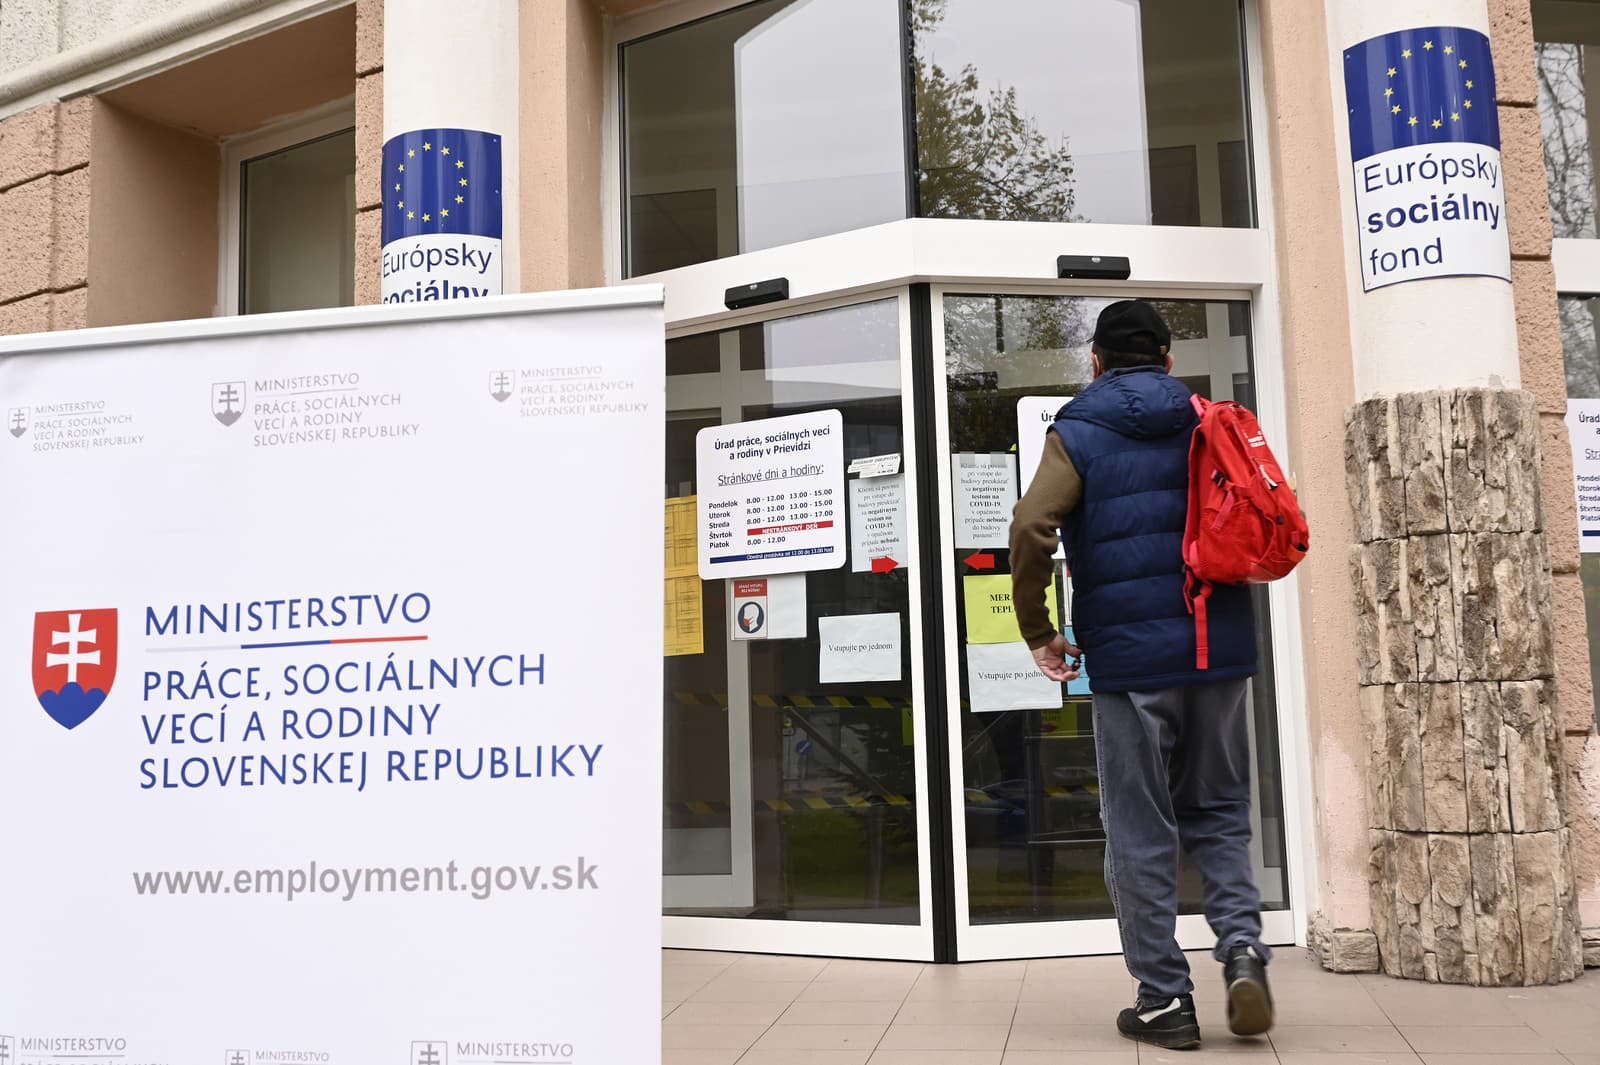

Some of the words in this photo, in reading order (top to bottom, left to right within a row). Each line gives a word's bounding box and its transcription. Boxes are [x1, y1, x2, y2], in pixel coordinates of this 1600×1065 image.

[1364, 153, 1497, 192] Európsky
[1367, 193, 1499, 233] sociálny
[383, 243, 492, 278] Európsky
[1369, 237, 1443, 275] fond
[521, 366, 602, 378] MINISTERSTVO
[254, 373, 360, 392] MINISTERSTVO
[560, 380, 634, 393] SOCIÁLNYCH
[35, 401, 105, 414] MINISTERSTVO
[254, 400, 300, 415] PRÁCE,
[304, 393, 401, 411] SOCIÁLNYCH
[521, 395, 545, 406] VECÍ
[549, 396, 557, 404] A
[560, 393, 606, 403] RODINY
[520, 405, 585, 416] SLOVENSKEJ
[590, 402, 649, 414] REPUBLIKY
[1041, 409, 1056, 422] Úr
[1579, 411, 1600, 423] Úrad
[68, 415, 132, 428] SOCIÁLNYCH
[254, 415, 285, 431] VECÍ
[290, 416, 299, 427] A
[304, 411, 363, 426] RODINY
[34, 431, 54, 440] VECÍ
[68, 428, 106, 437] RODINY
[254, 428, 336, 447] SLOVENSKEJ
[343, 424, 420, 439] REPUBLIKY
[714, 438, 734, 450] Úrad
[737, 436, 762, 449] práce,
[765, 429, 810, 443] sociálnych
[812, 425, 830, 436] vecí
[33, 440, 89, 452] SLOVENSKEJ
[93, 435, 144, 447] REPUBLIKY
[729, 452, 734, 460] a
[737, 447, 763, 459] rodiny
[773, 441, 811, 454] Prievidzi
[718, 469, 762, 484] Stránkové
[765, 467, 779, 479] dni
[782, 469, 787, 478] a
[791, 464, 824, 477] hodiny:
[709, 500, 738, 509] Pondelok
[747, 496, 761, 504] 8.00
[767, 494, 785, 503] 12.00
[789, 491, 808, 499] 13.00
[814, 489, 833, 497] 15.00
[709, 511, 730, 520] Utorok
[747, 507, 761, 515] 8.00
[767, 505, 785, 513] 12.00
[789, 502, 808, 510] 13.00
[814, 499, 833, 507] 15.00
[709, 520, 730, 529] Streda
[747, 517, 761, 525] 8.00
[767, 515, 785, 523] 12.00
[790, 512, 808, 520] 13.00
[815, 510, 833, 518] 17.00
[709, 530, 732, 540] Štvrtok
[709, 541, 730, 549] Piatok
[747, 538, 762, 546] 8.00
[768, 536, 786, 544] 12.00
[990, 594, 1010, 602] MER
[145, 592, 431, 636] MINISTERSTVO
[990, 606, 1014, 614] TEPL
[828, 643, 858, 654] Vstupujte
[859, 644, 867, 652] po
[868, 642, 893, 653] jednom
[143, 661, 272, 701] PRÁCE,
[283, 653, 546, 695] SOCIÁLNYCH
[977, 670, 1013, 681] Vstupujte
[1014, 672, 1024, 680] po
[1024, 670, 1046, 680] jedno
[141, 705, 228, 745] VECÍ
[242, 711, 267, 743] A
[282, 703, 441, 741] RODINY
[139, 751, 366, 792] SLOVENSKEJ
[386, 744, 604, 783] REPUBLIKY
[133, 857, 600, 901] www.employment.gov.sk
[21, 1037, 127, 1051] MINISTERSTVO
[457, 1042, 575, 1057] MINISTERSTVO
[255, 1051, 330, 1062] MINISTERSTVO
